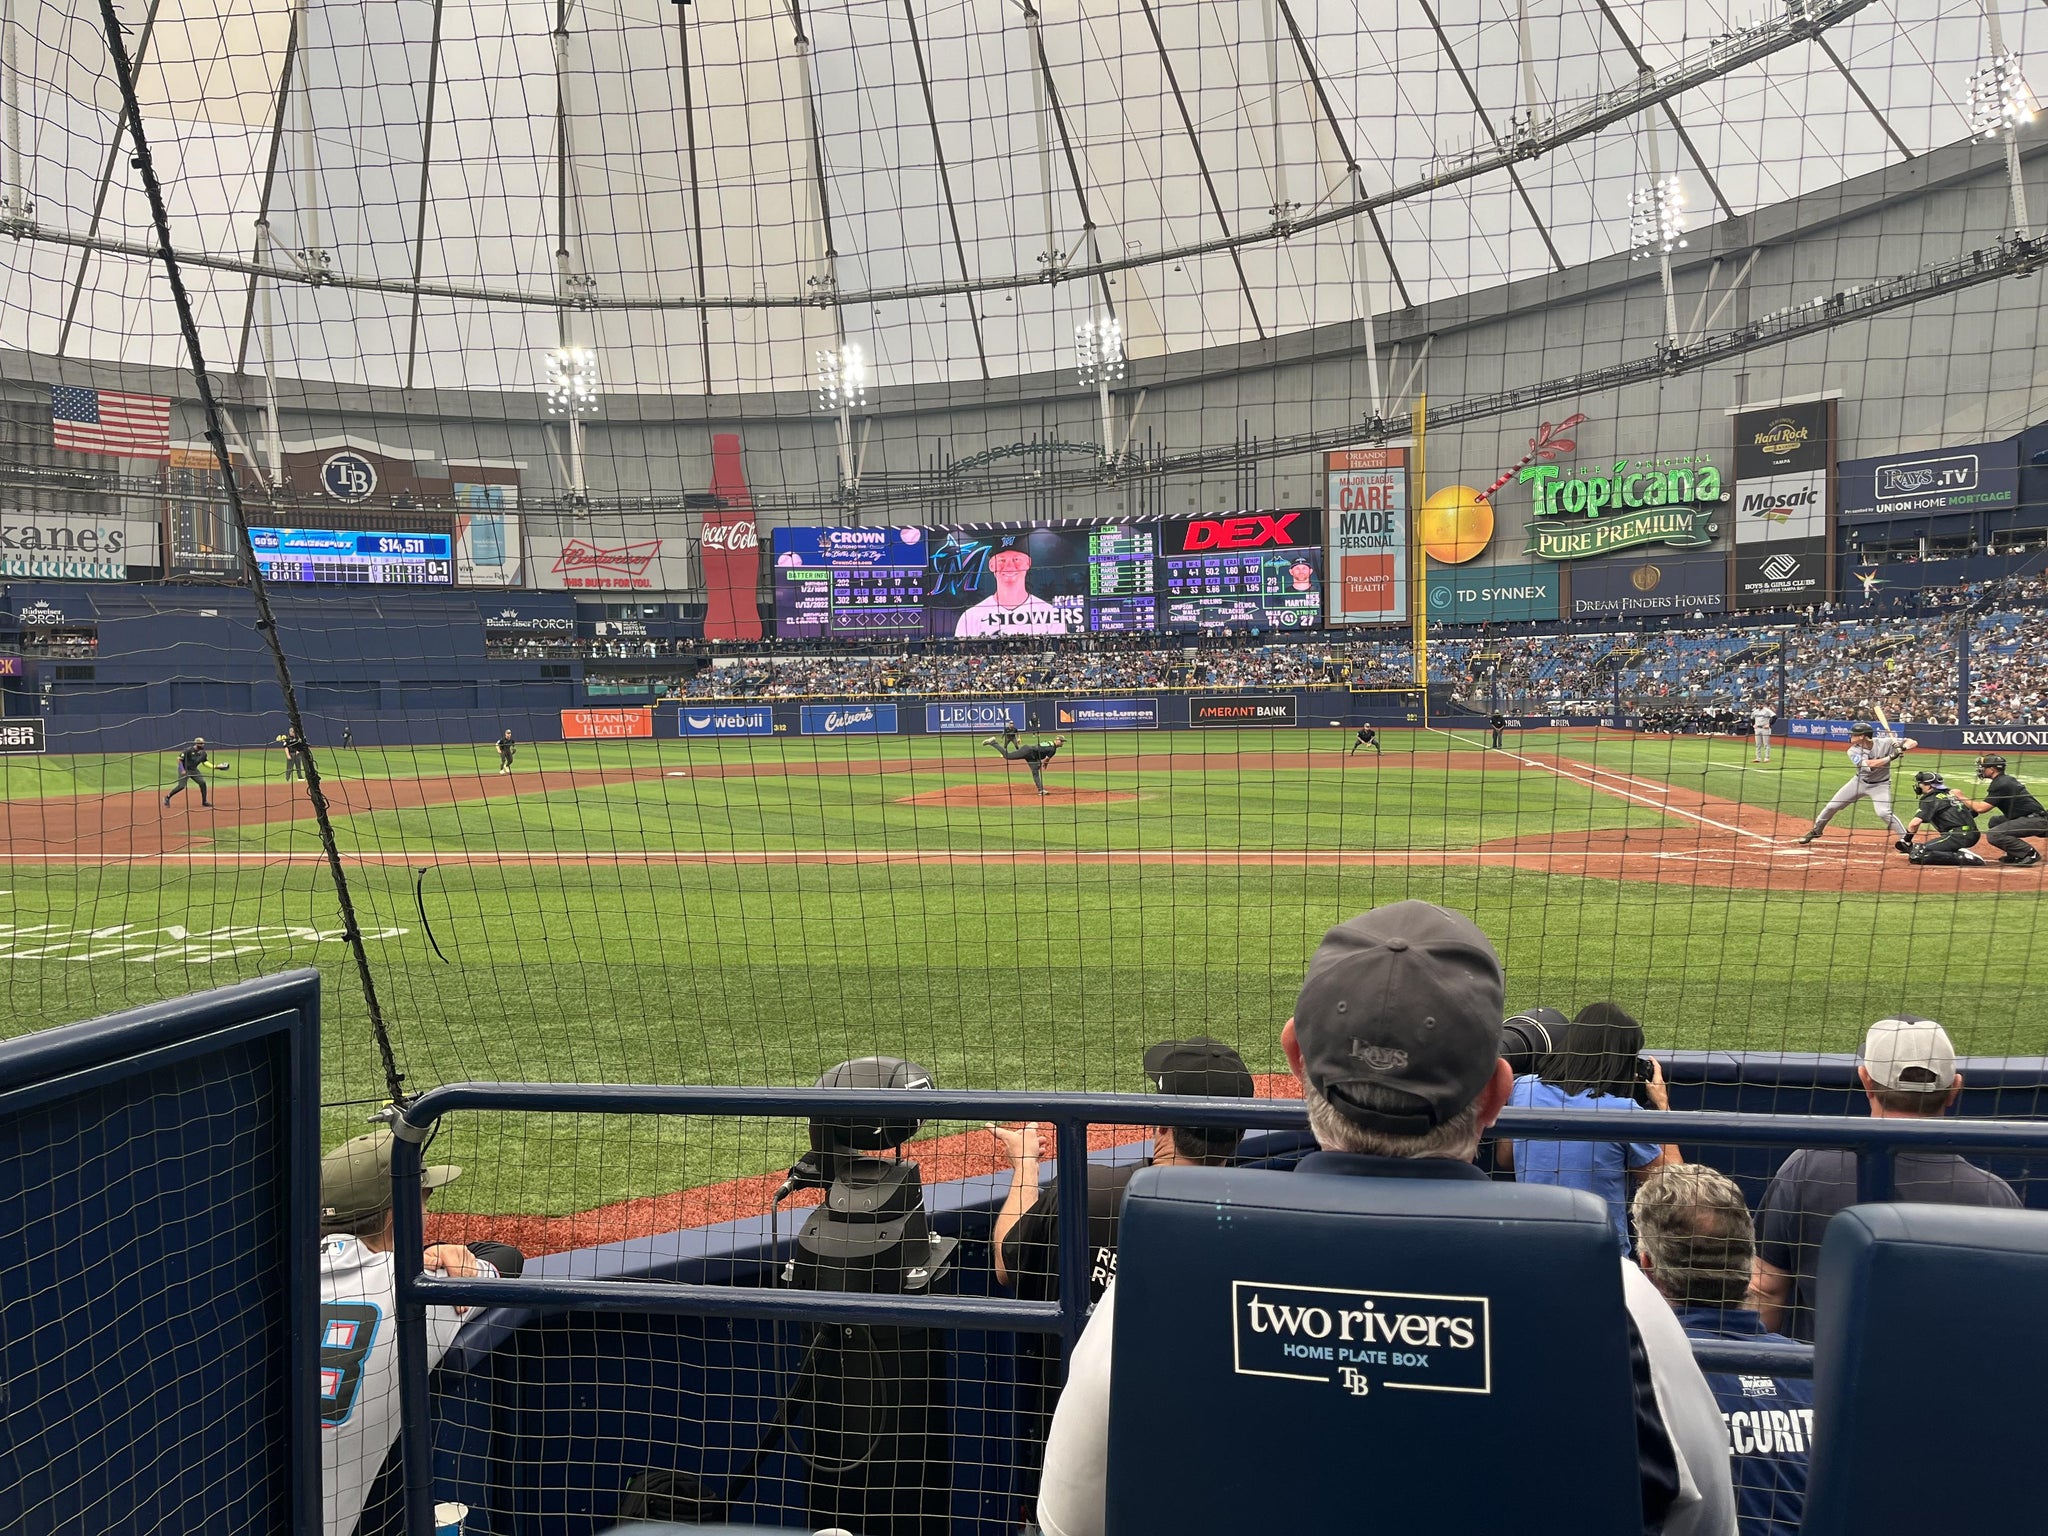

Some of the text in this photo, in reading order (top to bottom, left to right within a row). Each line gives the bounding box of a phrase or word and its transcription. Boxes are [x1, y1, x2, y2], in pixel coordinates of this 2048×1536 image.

[1755, 427, 1808, 444] Hard Rock
[1346, 452, 1386, 460] ORLANDO
[1350, 460, 1383, 468] HEALTH
[1567, 454, 1712, 476] THE ORIGINAL
[1339, 475, 1394, 486] MAJOR LEAGUE
[1519, 460, 1721, 518] Tropicana
[1339, 485, 1394, 511] CARE
[1742, 486, 1818, 512] Mosaic
[1876, 501, 1911, 513] UNION
[1914, 498, 1946, 509] HOME
[1948, 491, 2011, 505] MORTGAGE
[1340, 511, 1394, 535] MADE
[0, 526, 124, 553] kane's
[702, 521, 758, 550] Coca-Cola
[830, 532, 885, 544] CROWN
[1183, 513, 1300, 550] DEX
[1539, 514, 1693, 553] PURE PREMIUM
[285, 539, 352, 548] JACKPOT
[379, 537, 424, 553] $14,511
[1340, 535, 1394, 549] PERSONAL
[3, 554, 112, 564] FURNITURE
[563, 548, 650, 565] Budweiser
[428, 562, 447, 575] 0-1
[563, 578, 583, 587] THIS
[585, 578, 611, 587] BUD'S
[613, 578, 630, 587] FOR
[1346, 575, 1390, 583] ORLANDO
[1350, 583, 1385, 592] HEALTH
[1457, 585, 1546, 602] TD SYNNEX
[1054, 595, 1084, 606] KYLE
[1575, 594, 1721, 613] DREAM FINDERS HOMES
[19, 613, 65, 625] PORCH
[22, 607, 63, 615] Budweiser
[990, 608, 1084, 626] STOWERS
[487, 618, 573, 629] Budweiser PORCH
[1300, 615, 1314, 626] 27
[575, 713, 640, 723] ORLANDO
[825, 707, 873, 732] Culver's
[1199, 706, 1287, 718] AMERANT BANK
[715, 713, 763, 728] webull
[583, 724, 633, 735] HEALTH
[0, 736, 34, 745] IGN
[0, 924, 409, 942] LANDO
[1247, 1293, 1475, 1349] two rivers
[1284, 1343, 1429, 1367] HOME PLATE BOX
[1338, 1367, 1369, 1396] TB
